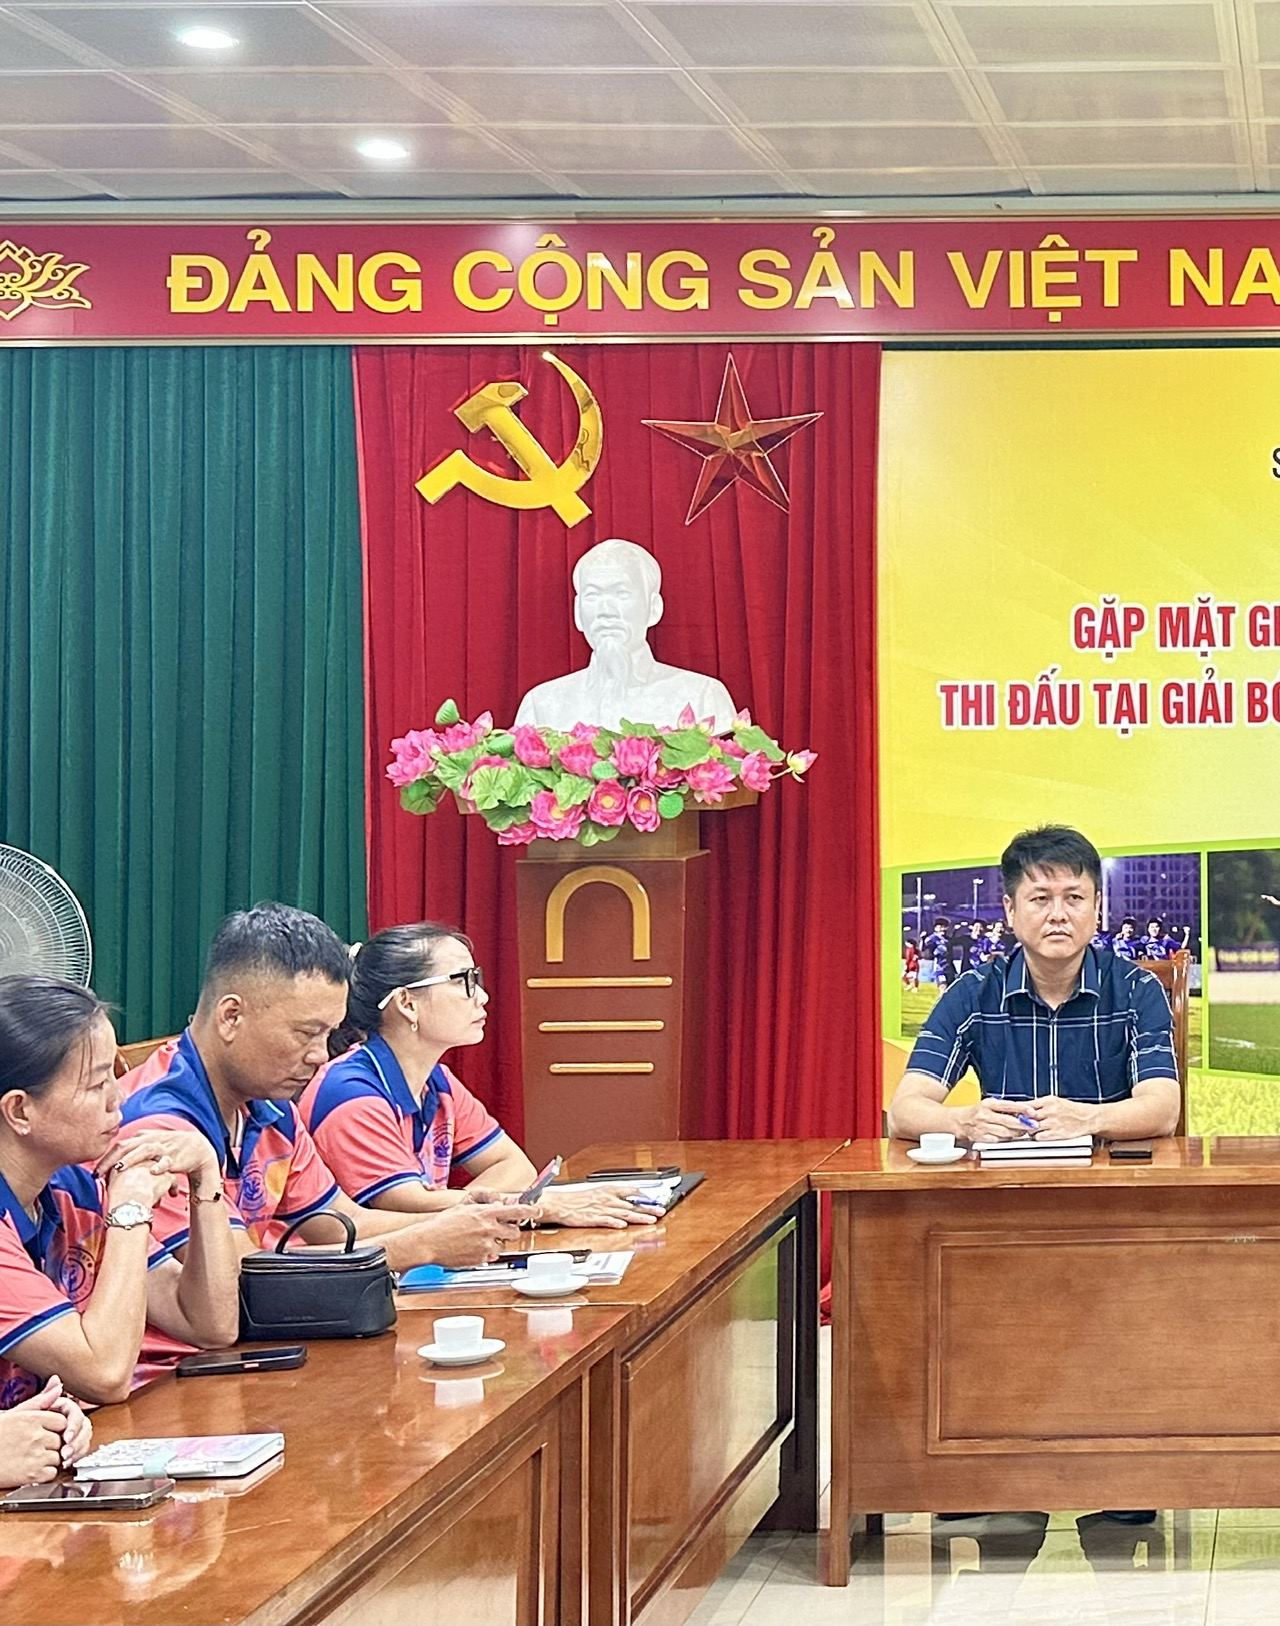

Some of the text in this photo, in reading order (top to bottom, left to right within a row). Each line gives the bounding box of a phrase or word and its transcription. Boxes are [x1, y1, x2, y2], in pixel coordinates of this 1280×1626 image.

[167, 228, 423, 313] ĐẢNG
[453, 234, 711, 325] CỘNG
[738, 226, 915, 310] SẢN
[948, 234, 1138, 322] VIỆT
[1073, 597, 1145, 658] GẶP
[1159, 597, 1236, 657] MẶT
[940, 684, 995, 726] THI
[1008, 667, 1080, 726] ĐẤU
[1093, 683, 1148, 734] TẠI
[1162, 667, 1233, 724] GIẢI
